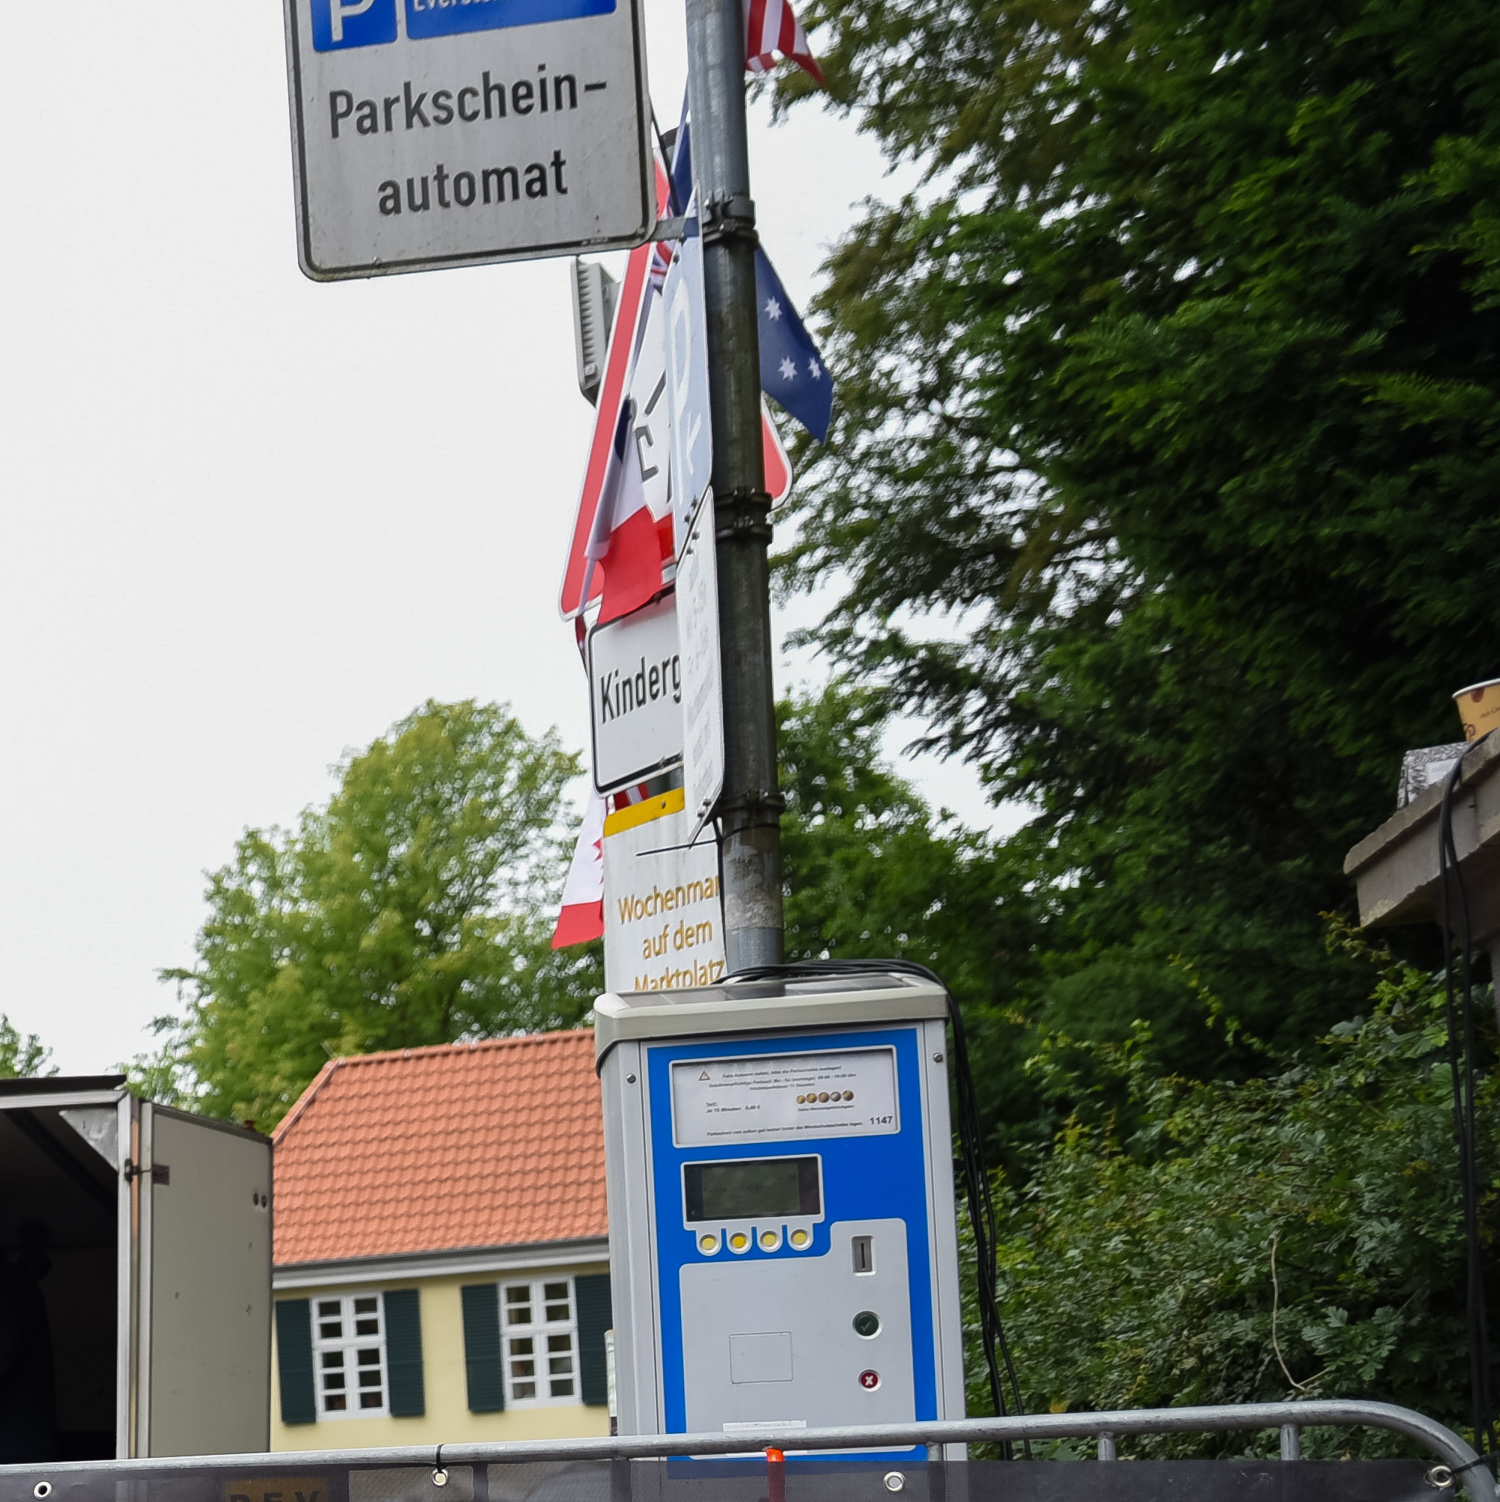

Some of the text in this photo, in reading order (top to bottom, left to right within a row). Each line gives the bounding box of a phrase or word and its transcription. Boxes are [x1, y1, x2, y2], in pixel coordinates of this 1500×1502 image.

[329, 64, 608, 140] Parkschein-
[378, 150, 568, 217] automat
[642, 919, 713, 960] auf dem
[869, 1116, 893, 1125] 1147
